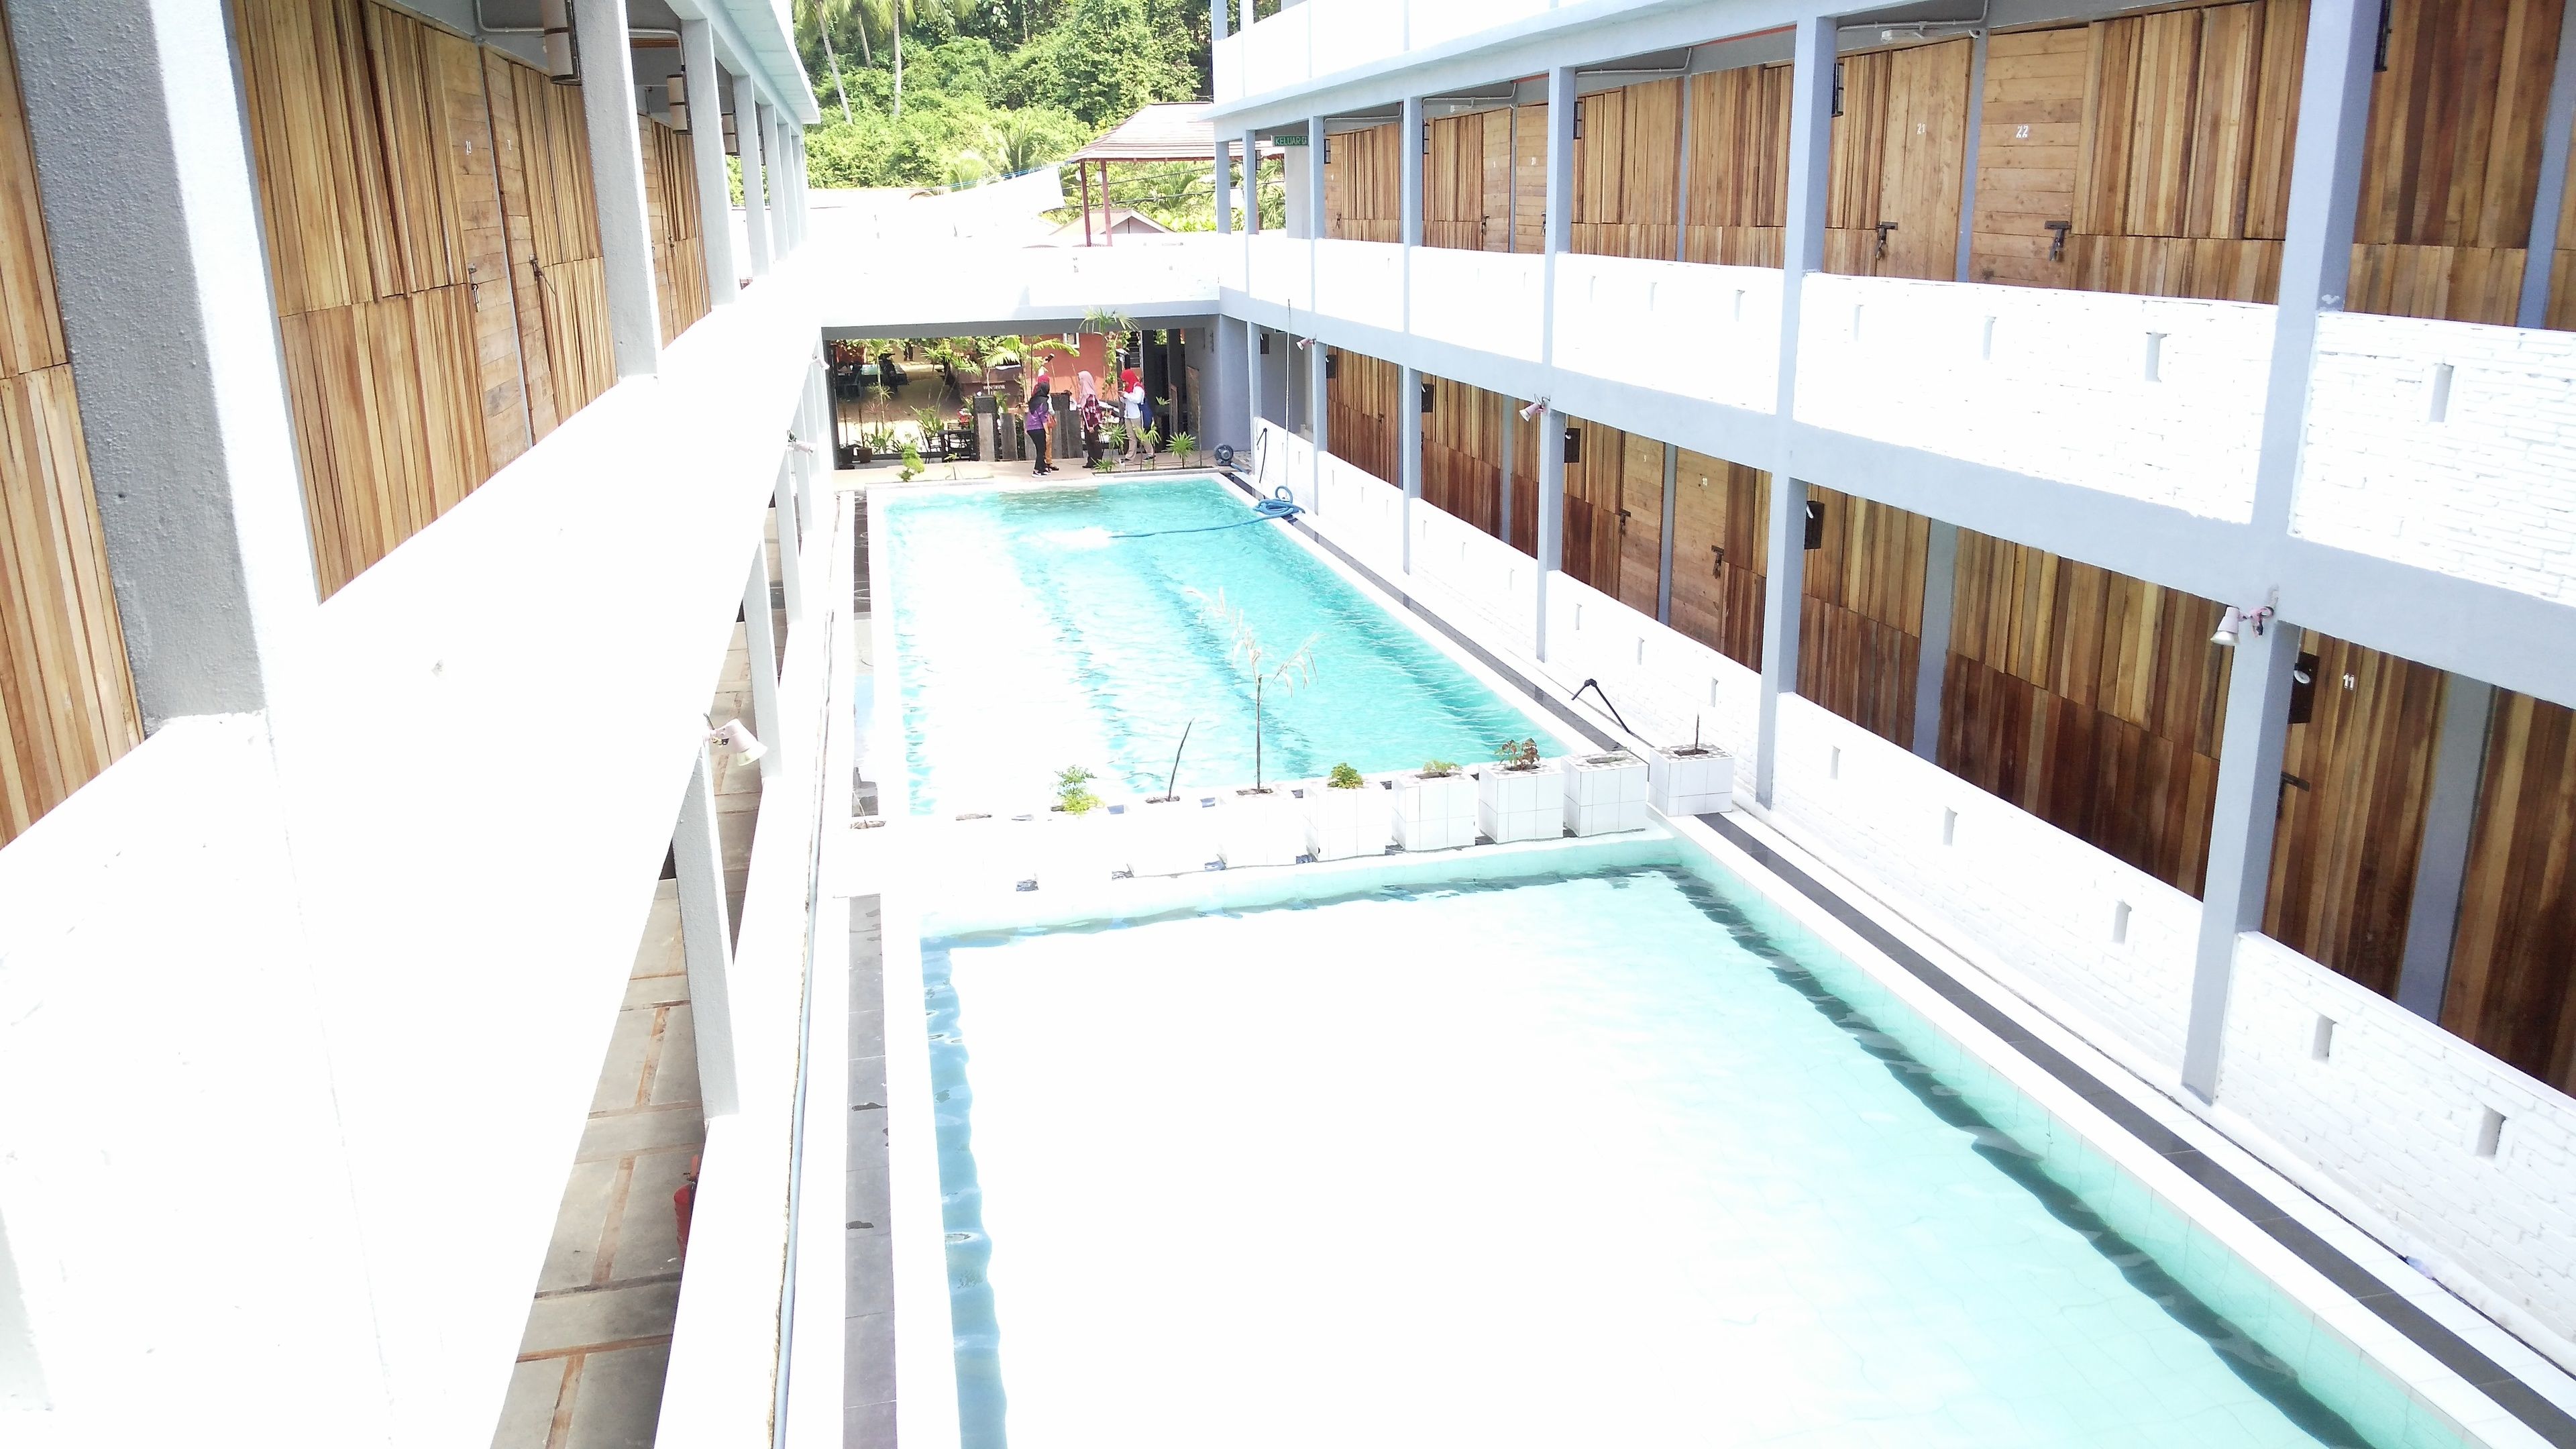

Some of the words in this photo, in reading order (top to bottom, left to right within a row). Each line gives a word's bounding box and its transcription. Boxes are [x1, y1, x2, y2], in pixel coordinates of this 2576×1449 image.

[1917, 123, 1925, 134] 21
[2016, 125, 2029, 138] 22
[1275, 137, 1301, 145] KELUAR
[2343, 674, 2355, 690] 11
